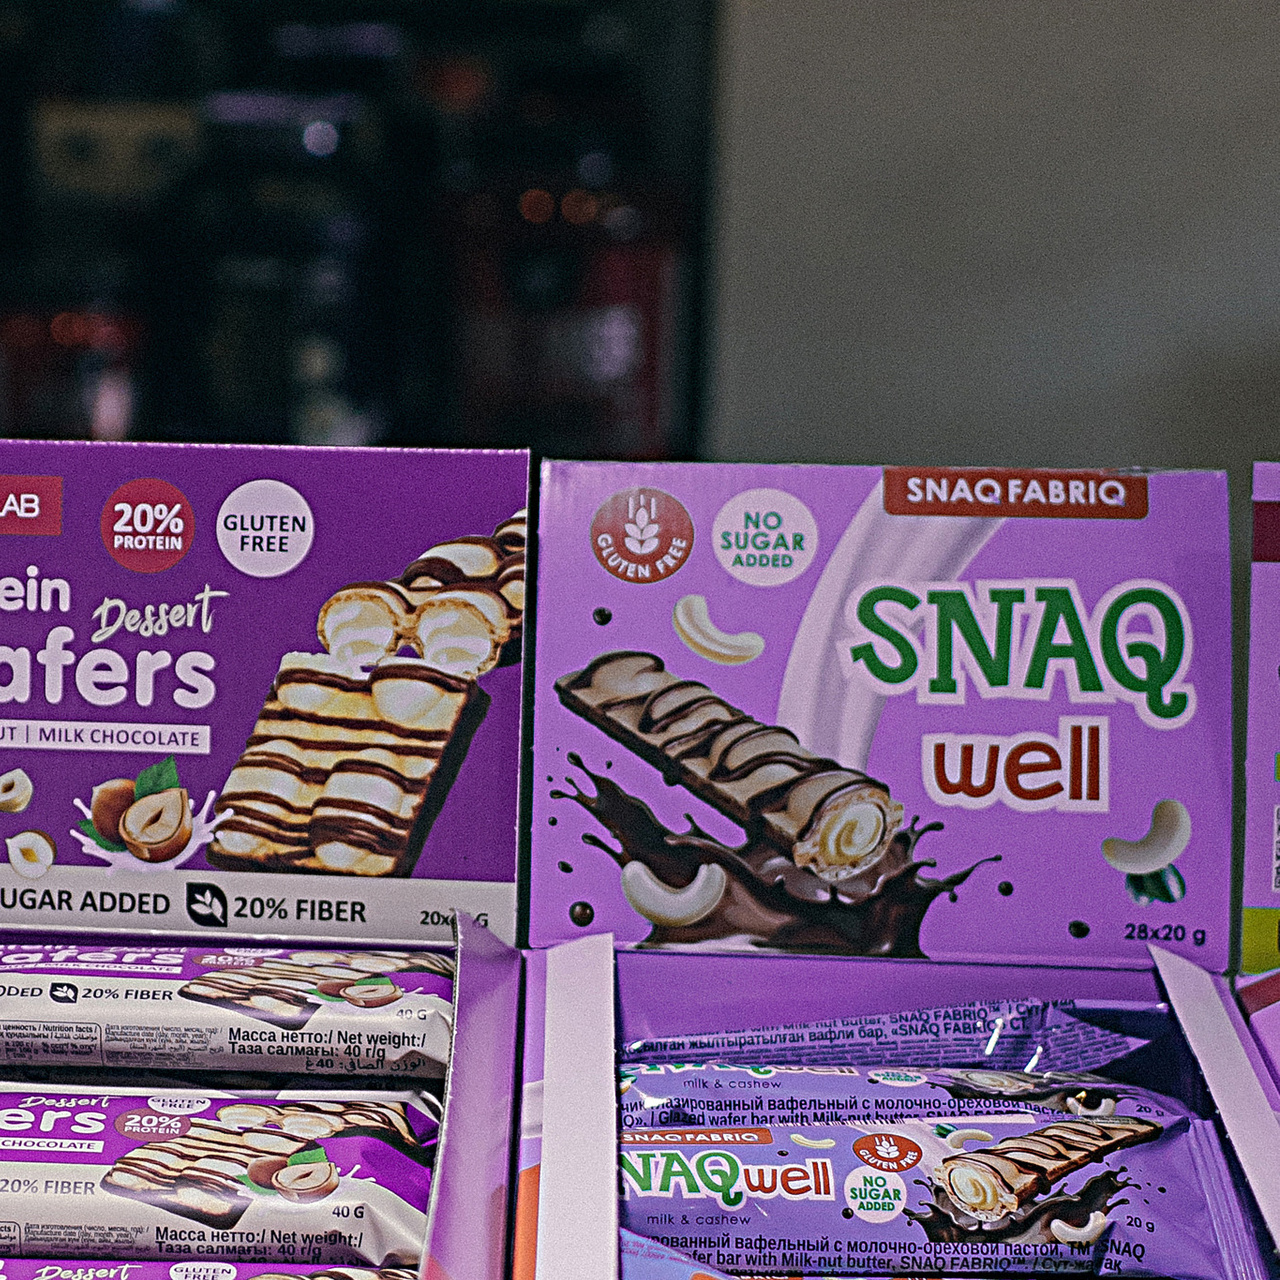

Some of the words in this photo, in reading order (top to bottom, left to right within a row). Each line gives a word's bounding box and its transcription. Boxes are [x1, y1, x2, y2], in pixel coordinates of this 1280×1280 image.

[906, 476, 1002, 507] SNAQ
[1008, 479, 1126, 507] FABRIQ
[113, 502, 184, 533] 20%
[224, 513, 307, 535] GLUTEN
[744, 511, 782, 530] NO
[114, 534, 183, 552] PROTEIN
[238, 533, 290, 554] FREE
[721, 532, 805, 551] SUGAR
[597, 533, 650, 578] GLUTEN
[655, 536, 687, 574] FREE
[732, 554, 793, 568] ADDED
[91, 583, 230, 642] Dessert
[847, 583, 1191, 723] SNAQ
[39, 726, 84, 745] MILK
[90, 728, 200, 747] CHOCOLATE
[930, 722, 1105, 805] well
[80, 889, 171, 916] ADDED
[233, 896, 288, 920] 20%
[296, 899, 366, 923] FIBER
[1124, 922, 1186, 943] 28x20
[1193, 927, 1207, 947] g
[81, 988, 119, 1000] 20%
[125, 989, 173, 1001] FIBER
[396, 1008, 414, 1020] 40
[417, 1010, 427, 1020] G
[229, 1027, 276, 1043] Масса
[337, 1031, 363, 1045] Net
[230, 1042, 263, 1055] Таза
[344, 1045, 361, 1057] 40
[683, 1079, 708, 1089] milk
[728, 1080, 782, 1089] cashew
[18, 1095, 116, 1110] Dessert
[150, 1097, 207, 1105] GLUTEN
[160, 1102, 194, 1110] FREE
[768, 1097, 859, 1110] вафельный
[124, 1114, 182, 1129] 20%
[124, 1126, 181, 1135] PROTEIN
[1, 1140, 95, 1150] CHOCOLATE
[859, 1148, 899, 1170] GLUTEN
[900, 1150, 918, 1168] FREE
[44, 1180, 95, 1195] FIBER
[620, 1152, 832, 1207] NAQwell
[863, 1176, 886, 1187] NO
[850, 1188, 902, 1200] SUGAR
[332, 1205, 350, 1218] 40
[354, 1206, 364, 1219] G
[857, 1202, 896, 1212] ADDED
[647, 1214, 674, 1225] milk
[696, 1214, 751, 1225] cashew
[1126, 1216, 1143, 1227] 20
[1146, 1221, 1155, 1233] g
[155, 1226, 205, 1242] Масса
[270, 1230, 306, 1244] Net
[157, 1242, 192, 1255] Таза
[735, 1235, 830, 1254] вафельный
[716, 1252, 748, 1266] bar
[752, 1252, 777, 1266] with
[781, 1252, 842, 1268] Milk-nut
[846, 1254, 896, 1270] butter,
[173, 1266, 231, 1275] GLUTEN
